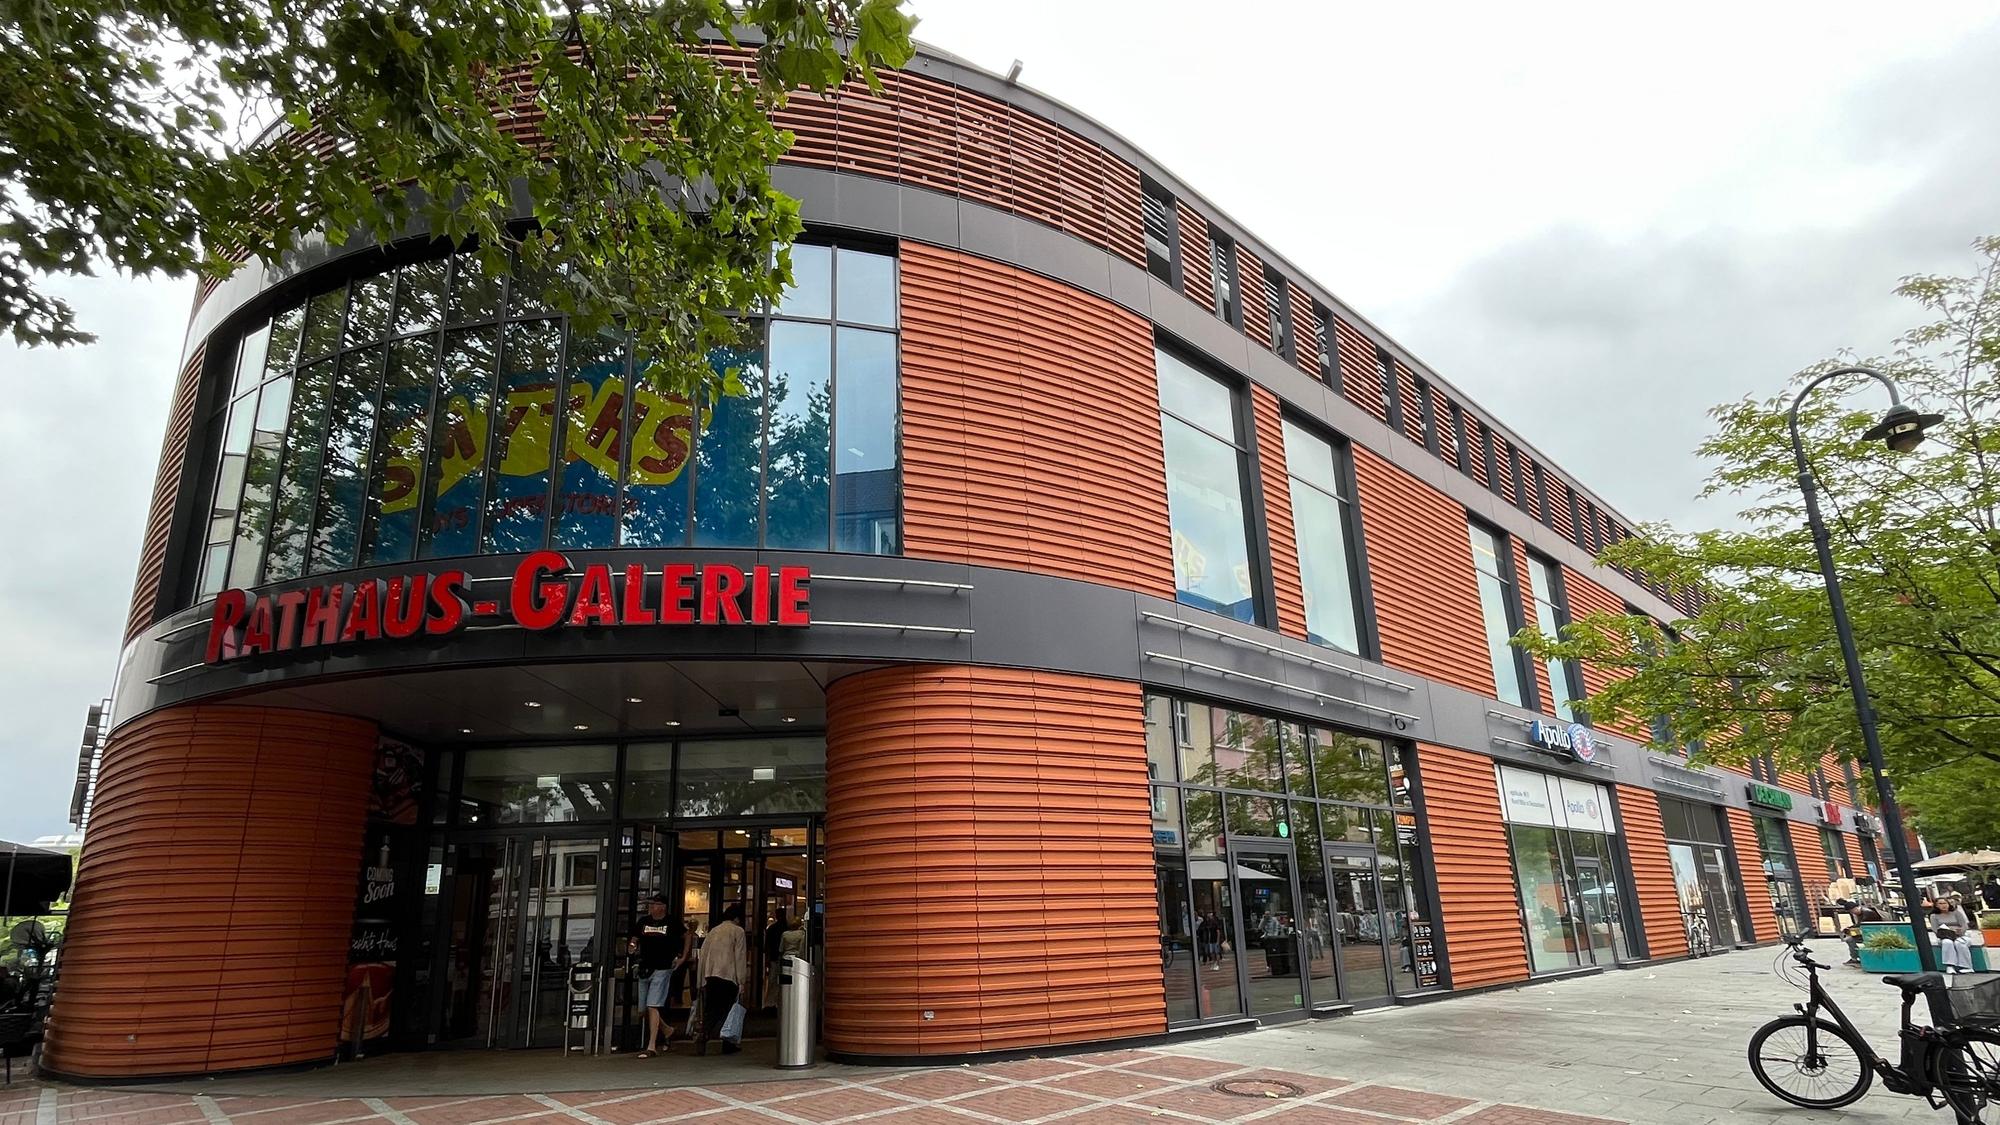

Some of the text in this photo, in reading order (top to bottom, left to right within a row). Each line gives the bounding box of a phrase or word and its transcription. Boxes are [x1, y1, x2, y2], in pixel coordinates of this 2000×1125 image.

[1538, 720, 1572, 749] Apollo
[366, 866, 394, 882] COMING
[363, 881, 395, 904] Soon
